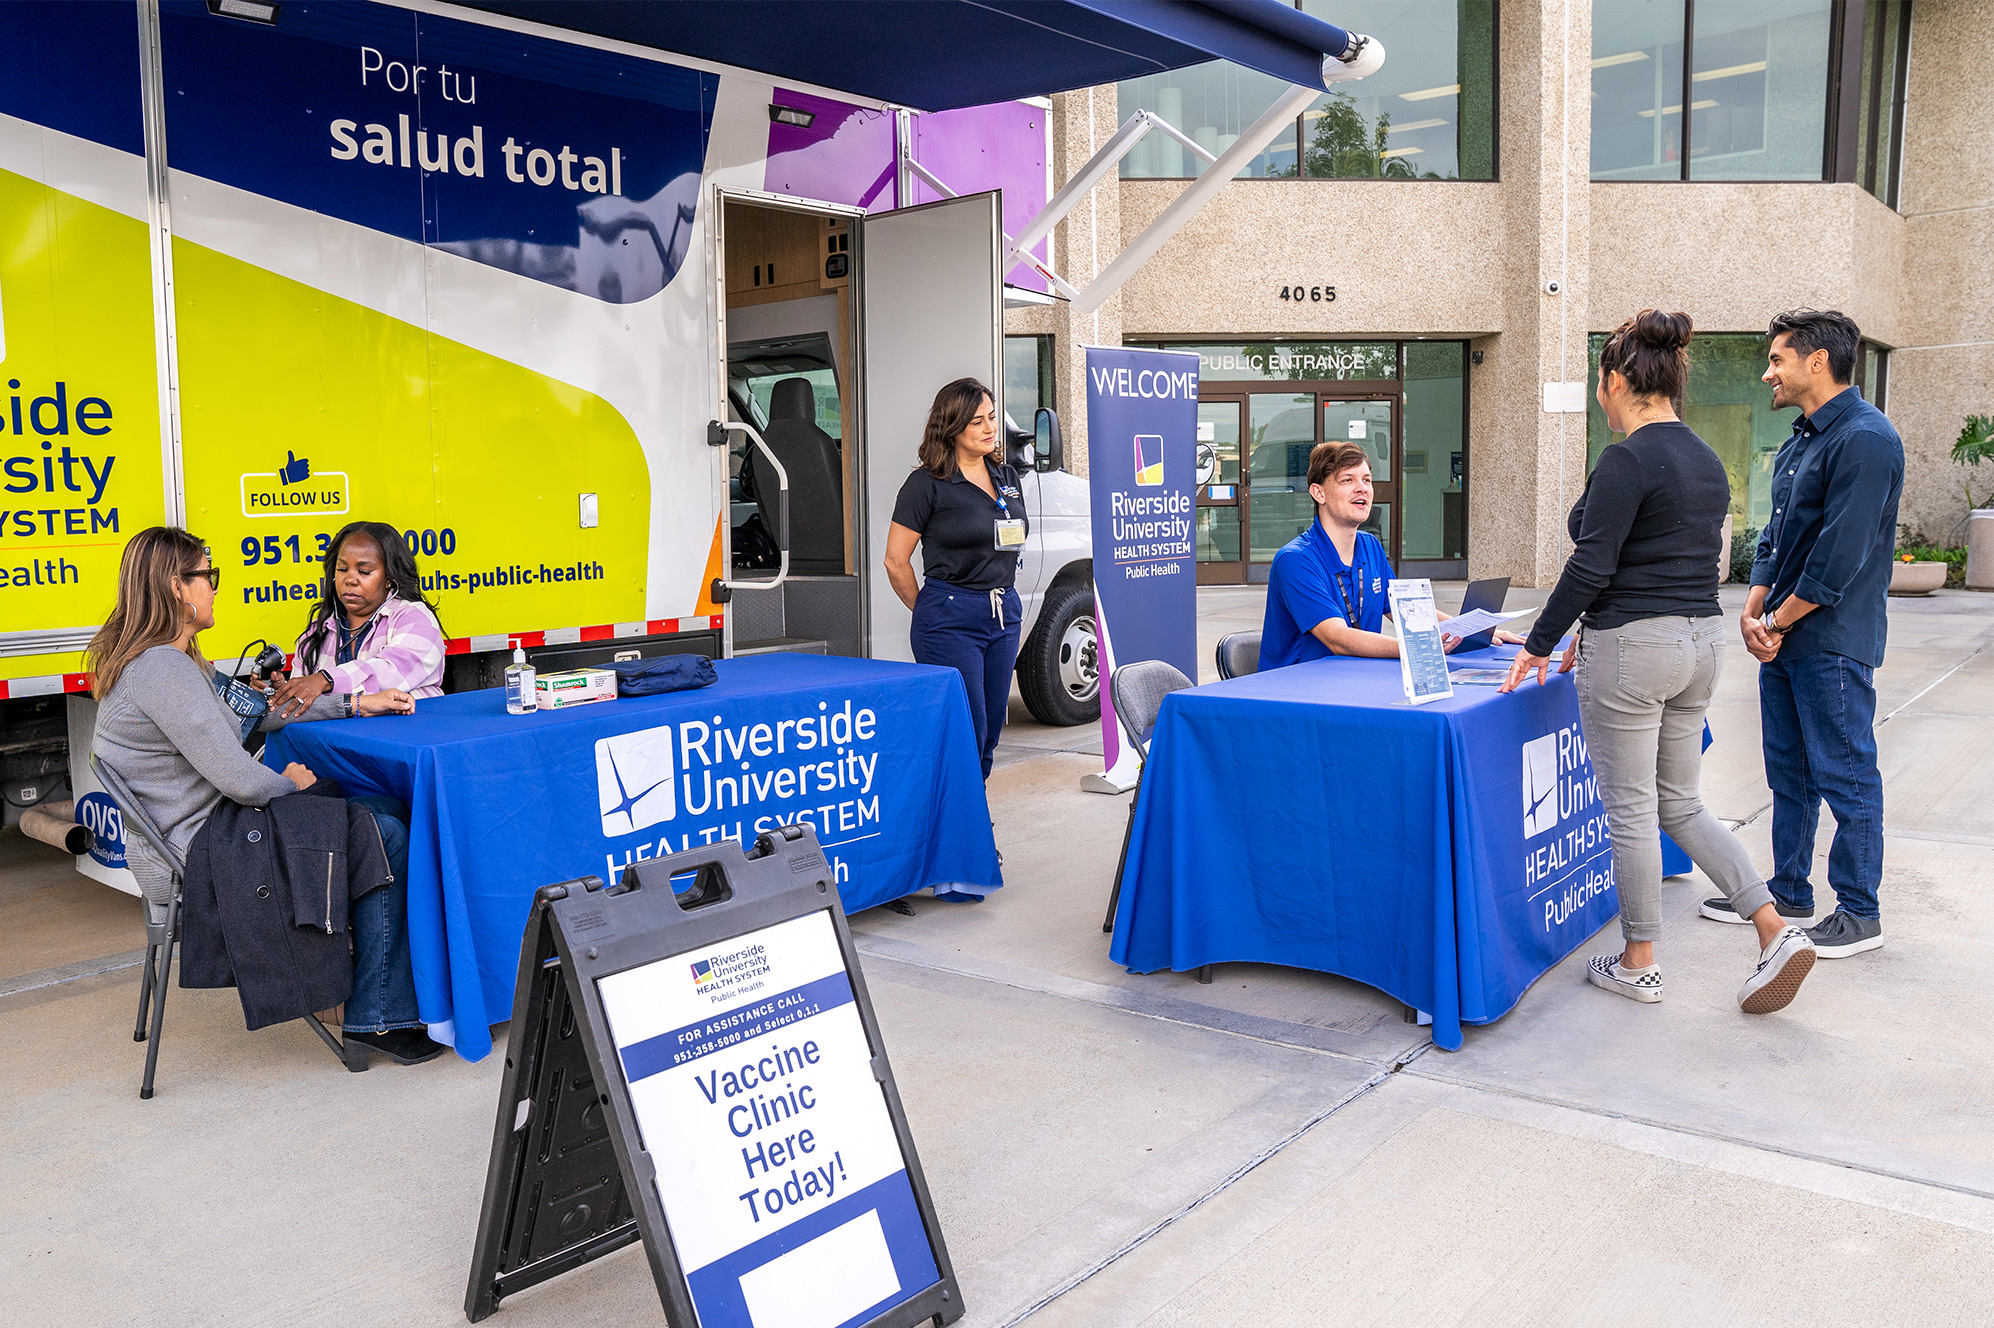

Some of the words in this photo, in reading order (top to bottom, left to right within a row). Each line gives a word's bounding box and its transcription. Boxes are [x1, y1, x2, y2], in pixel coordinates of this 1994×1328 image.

[361, 46, 427, 94] Por
[438, 64, 475, 104] tu
[330, 113, 484, 178] salud
[501, 137, 622, 196] total
[1280, 286, 1336, 302] 4065
[1199, 354, 1263, 370] PUBLIC
[1269, 354, 1364, 370] ENTRANCE
[1091, 367, 1197, 400] WELCOME
[0, 378, 113, 436] ide
[0, 440, 116, 505] sity
[251, 492, 316, 506] FOLLOW
[321, 491, 340, 504] US
[1111, 490, 1190, 517] Riverside
[1113, 515, 1190, 541] University
[1114, 545, 1149, 560] HEALTH
[1151, 541, 1190, 556] SYSTEM
[1125, 564, 1149, 579] Public
[1151, 563, 1180, 577] Health
[244, 577, 326, 603] ruheal
[421, 561, 604, 594] uhs-public-health
[553, 679, 584, 688] Shamrock
[680, 700, 877, 770] Riverside
[683, 747, 878, 815] University
[1586, 859, 1615, 902] Heal
[710, 944, 765, 968] Riverside
[713, 955, 767, 978] University
[696, 977, 733, 995] HEALTH
[735, 965, 771, 983] SYSTEM
[711, 990, 736, 1004] Public
[738, 981, 764, 995] Health
[673, 1032, 741, 1064] 951-358-5000
[743, 1024, 761, 1038] and
[764, 1012, 795, 1031] Select
[797, 1003, 820, 1019] 0,1,1
[677, 1029, 702, 1045] FOR
[706, 1003, 775, 1036] ASSISTANCE
[777, 992, 805, 1010] CALL
[694, 1041, 820, 1104] Vaccine
[728, 1083, 816, 1138] Clinic
[742, 1129, 816, 1179] Here
[739, 1151, 847, 1224] Today!
